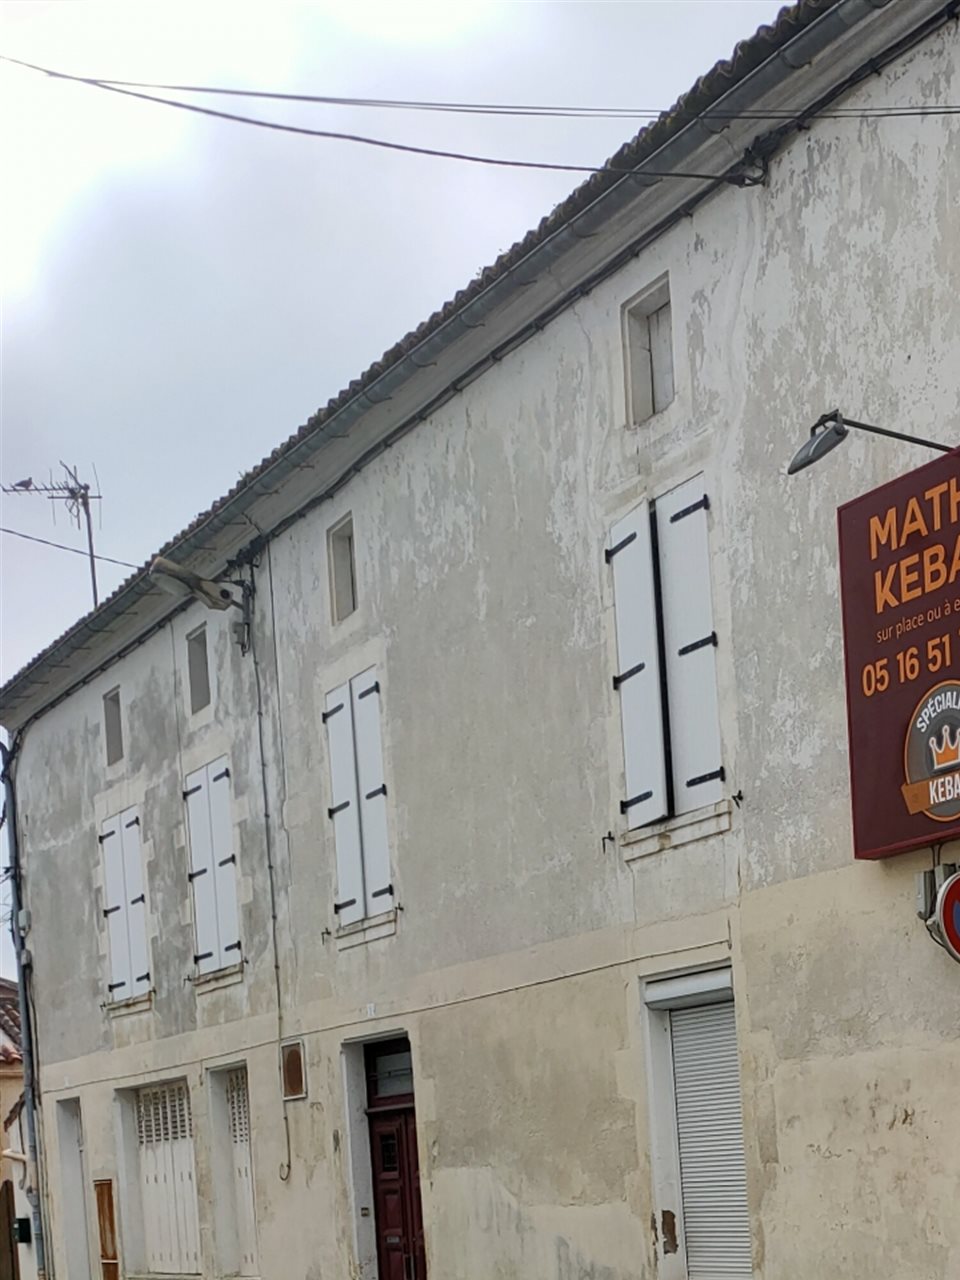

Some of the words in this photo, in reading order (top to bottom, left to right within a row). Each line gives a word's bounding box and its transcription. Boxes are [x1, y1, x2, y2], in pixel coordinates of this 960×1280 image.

[876, 625, 893, 643] sur
[896, 613, 925, 639] place
[927, 606, 941, 622] ou
[944, 599, 950, 615] à
[862, 657, 890, 697] 05
[896, 646, 919, 683] 16
[927, 633, 951, 673] 51
